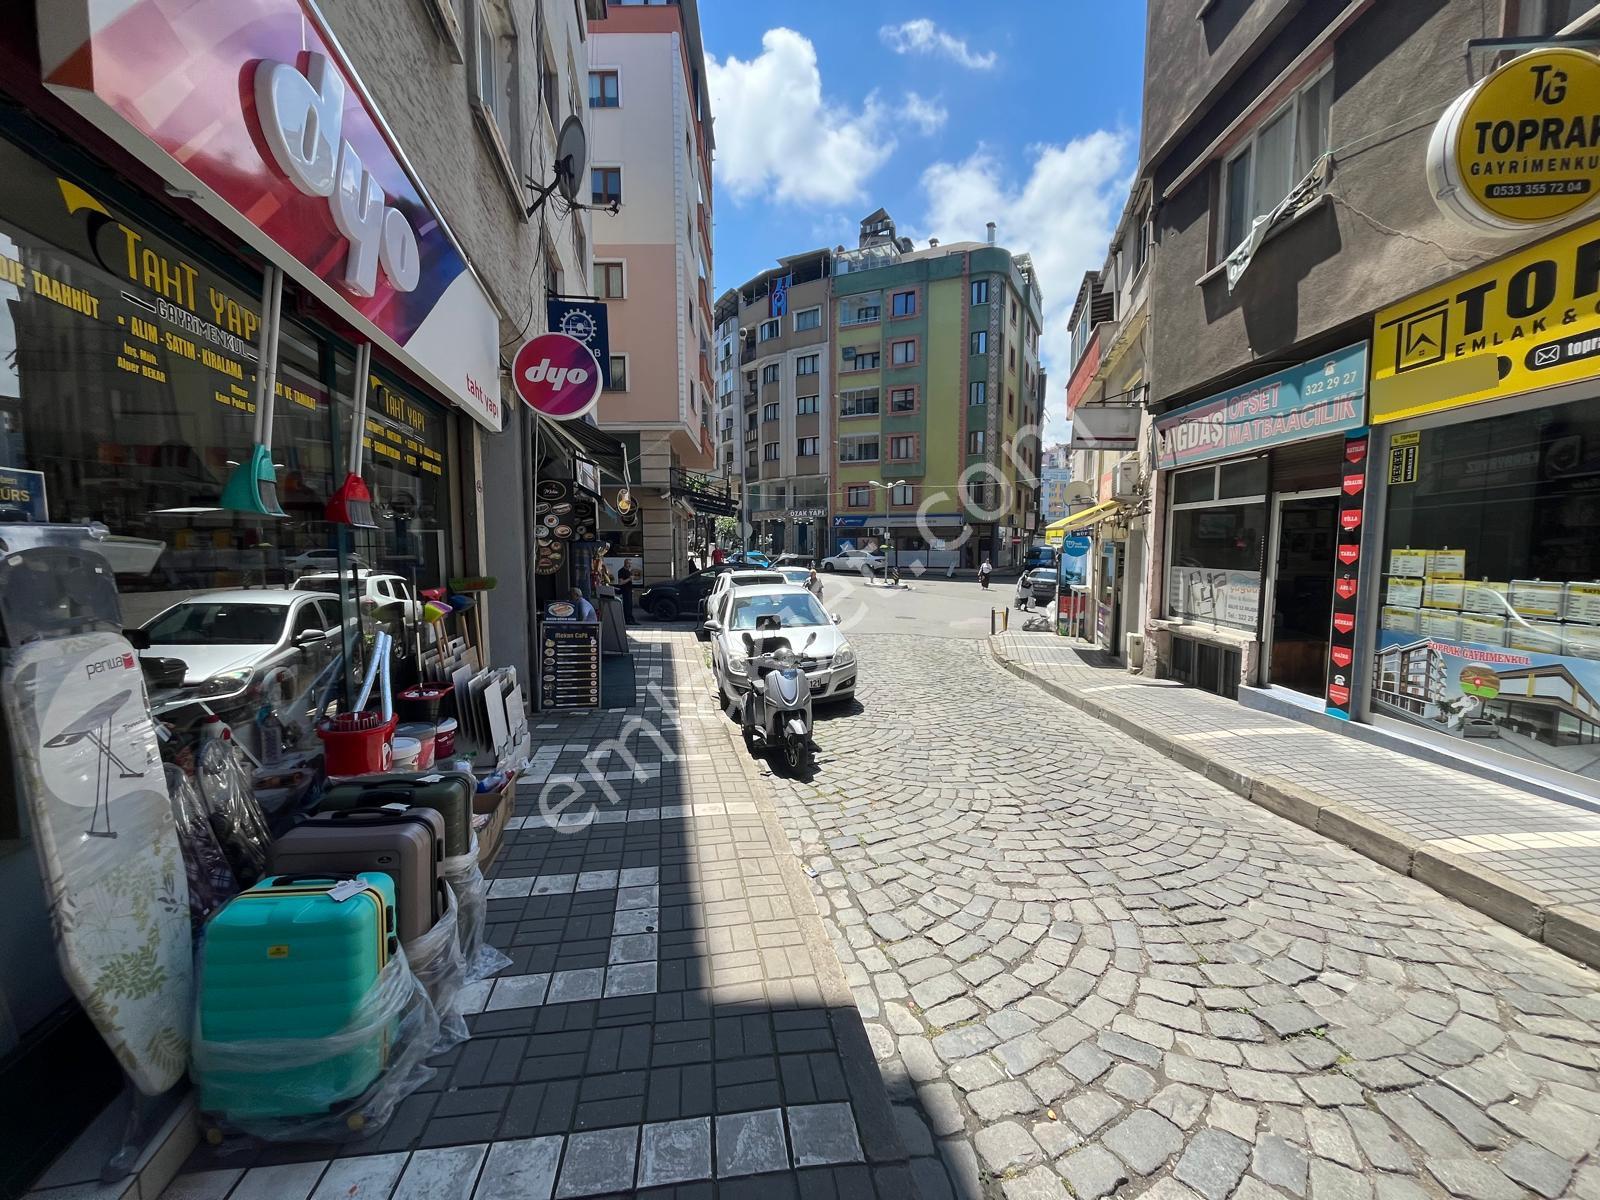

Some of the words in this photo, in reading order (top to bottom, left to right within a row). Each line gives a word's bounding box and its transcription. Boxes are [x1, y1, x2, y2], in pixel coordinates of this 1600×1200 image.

[248, 51, 421, 297] dyo
[1493, 185, 1521, 196] 0533
[1525, 184, 1546, 194] 355
[1550, 183, 1563, 193] 72
[1567, 182, 1582, 193] 04
[118, 223, 199, 312] TAHT
[32, 269, 99, 320] TAAHHÜT
[131, 316, 158, 345] ALIM
[166, 331, 196, 361] SATIM
[202, 348, 243, 381] KİRALAMA
[156, 297, 248, 359] GAYRİMENKUL
[1455, 317, 1547, 357] EMLAK
[1562, 308, 1578, 325] &
[466, 373, 483, 403] taht
[484, 394, 499, 418] yapı
[524, 358, 588, 391] dyo
[1305, 382, 1324, 396] 322
[1327, 376, 1340, 390] 29
[1343, 371, 1357, 384] 27
[384, 387, 405, 421] TAHT
[407, 406, 425, 432] YAPI
[1227, 391, 1357, 446] MATBAACILIK
[1228, 382, 1282, 419] OFSET
[809, 509, 825, 517] YAPI
[1427, 641, 1460, 656] TOPRAK
